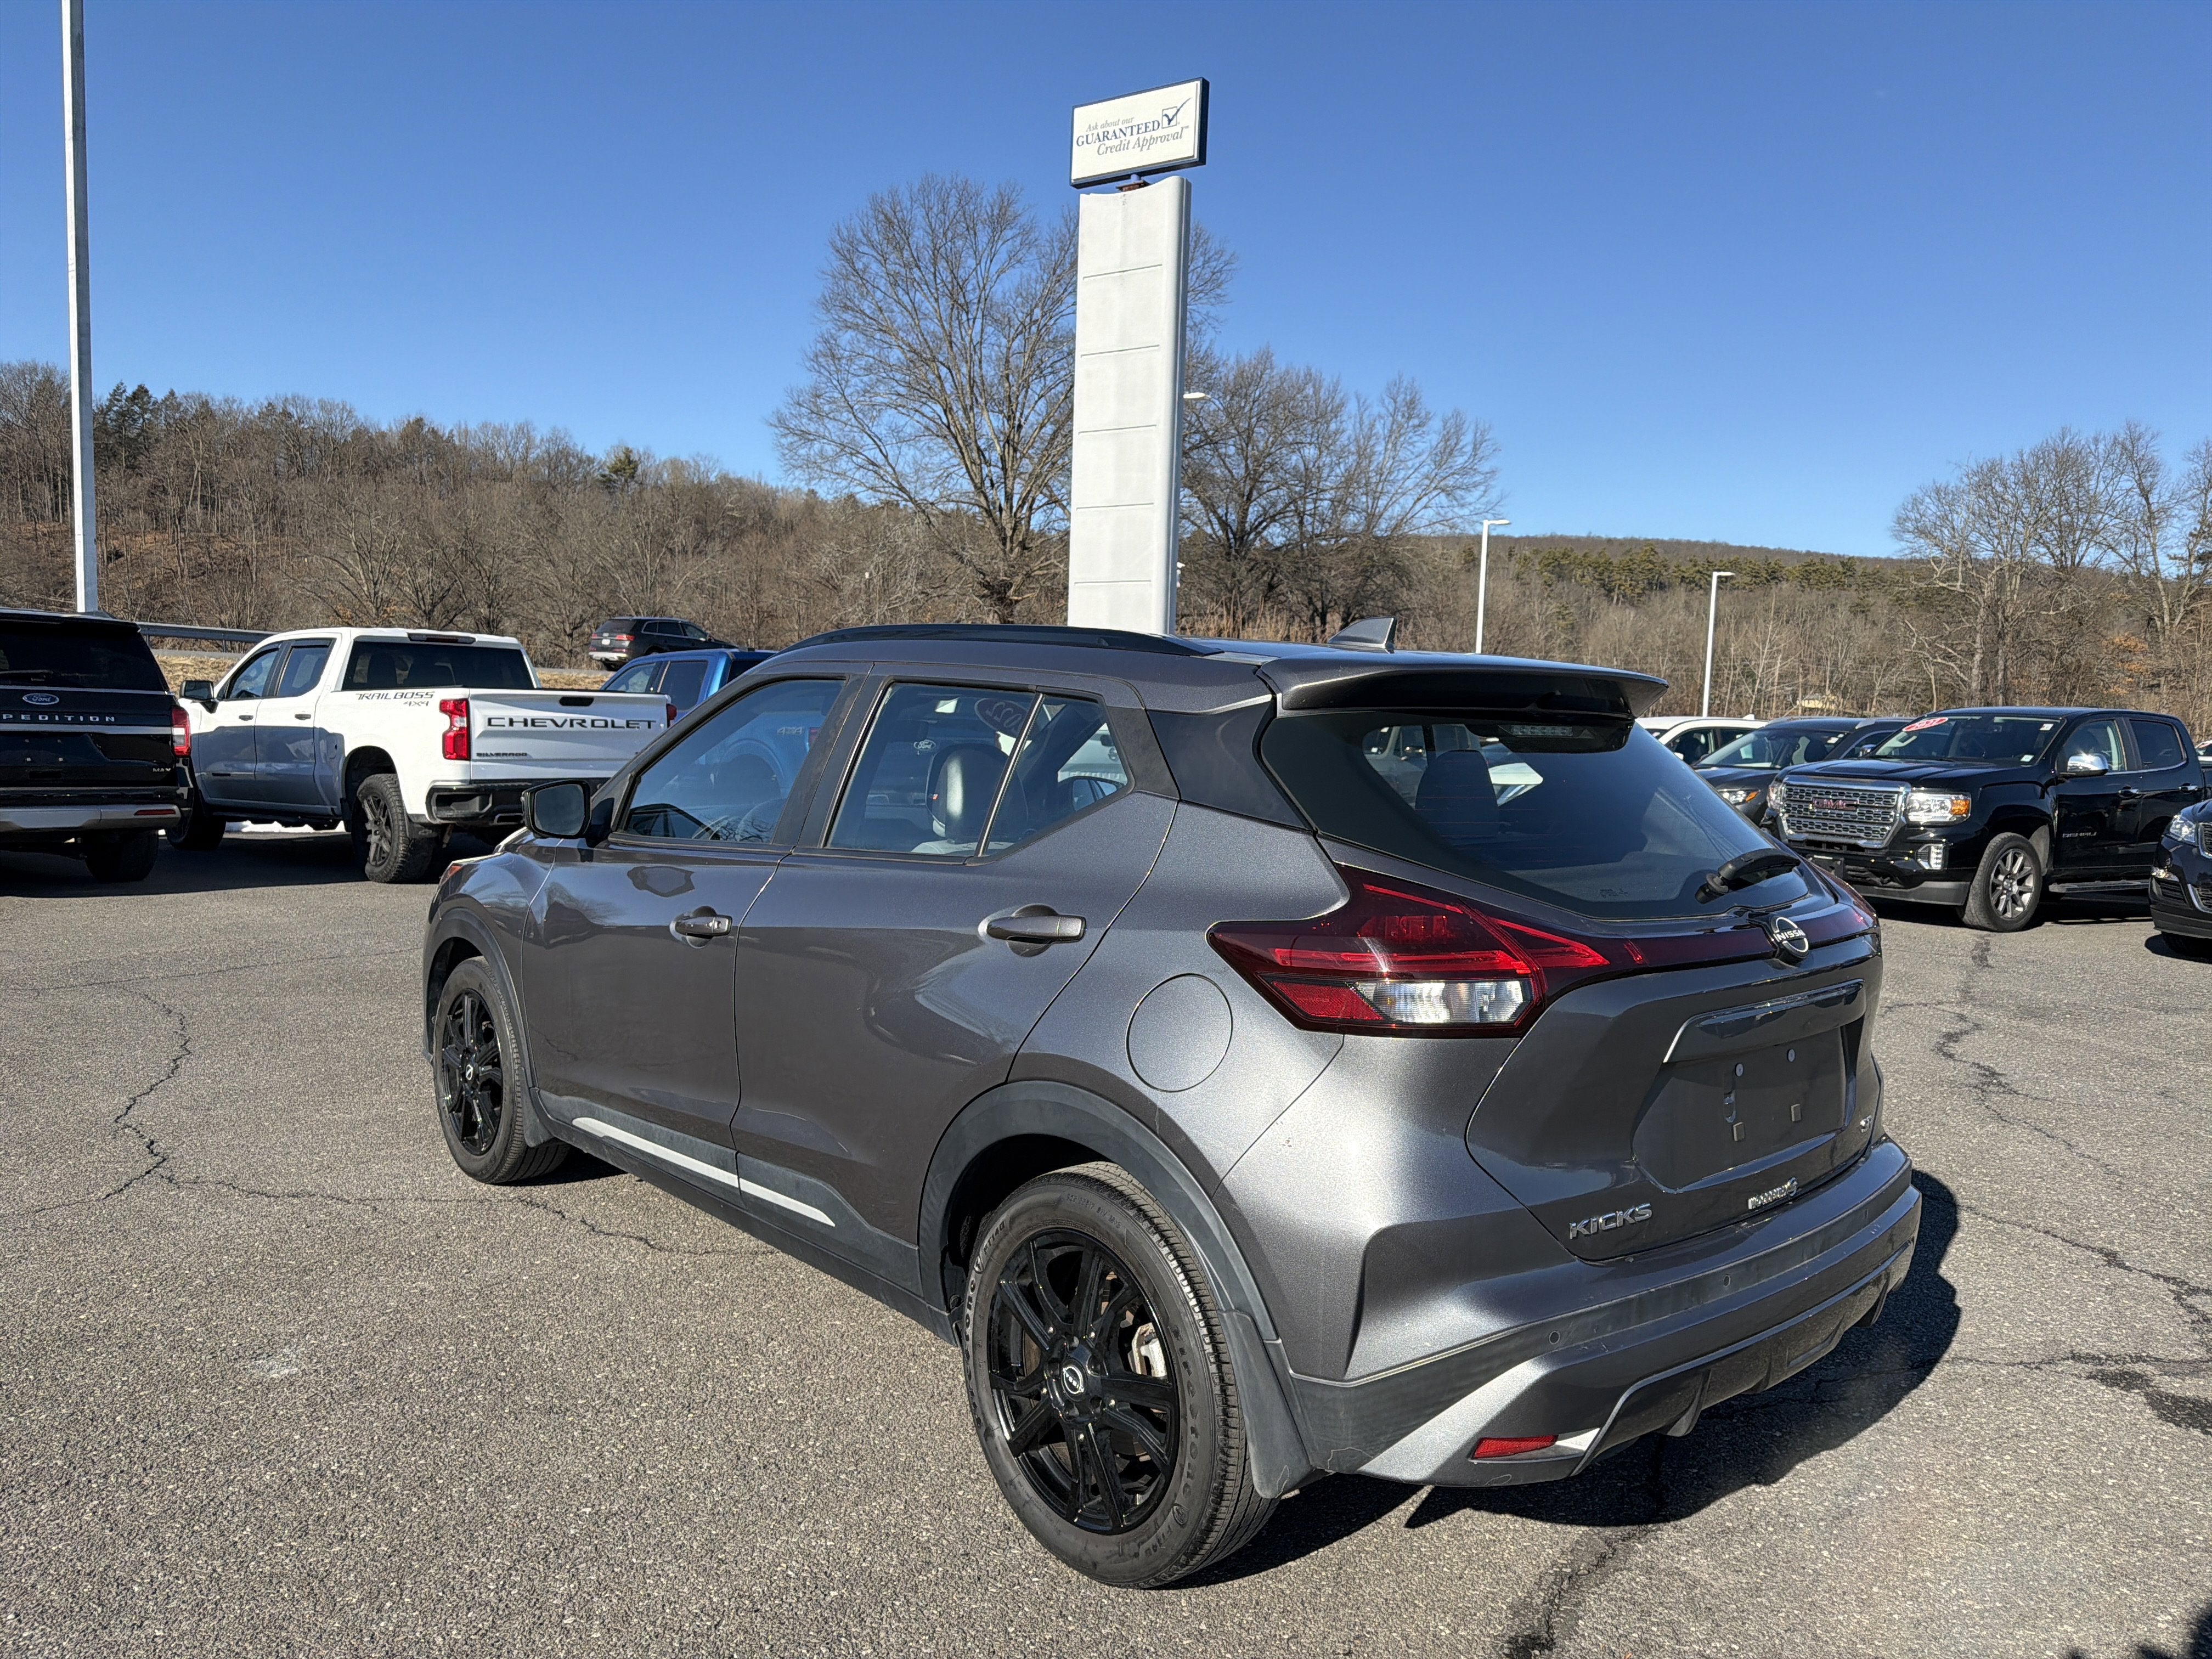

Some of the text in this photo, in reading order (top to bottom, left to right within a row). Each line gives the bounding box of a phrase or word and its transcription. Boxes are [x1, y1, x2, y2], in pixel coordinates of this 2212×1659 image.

[1086, 116, 1135, 132] Ask about our
[1076, 120, 1160, 146] GUARANTEED
[1097, 126, 1184, 155] Credit Approval
[393, 691, 435, 699] BOSS
[487, 717, 657, 729] CHEVROLET
[1813, 798, 1858, 810] GMC
[1570, 1203, 1653, 1239] KICKS
